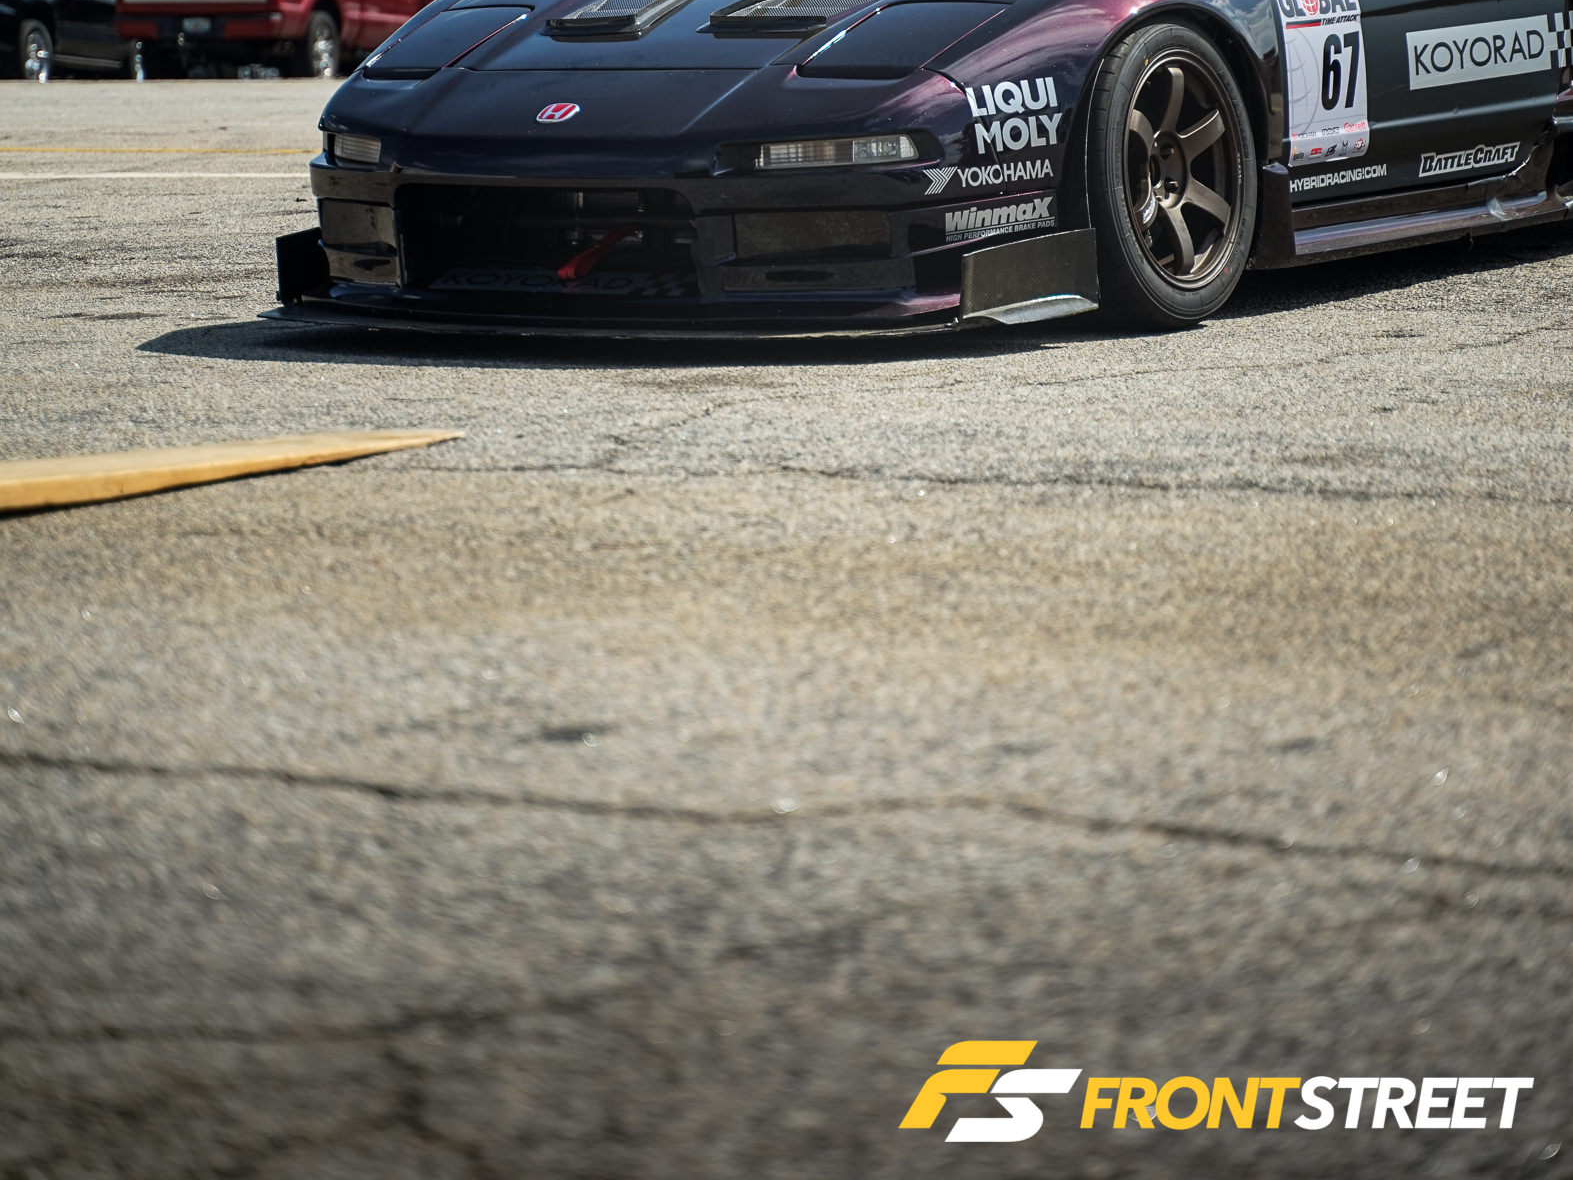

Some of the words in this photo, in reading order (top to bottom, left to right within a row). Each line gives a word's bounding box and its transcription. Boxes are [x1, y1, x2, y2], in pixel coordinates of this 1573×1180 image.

[1321, 17, 1335, 26] TIME
[1335, 14, 1358, 24] ATTACK
[1413, 29, 1545, 76] KOYORAD
[1321, 31, 1360, 111] 67
[965, 76, 1058, 117] LIQUI
[974, 112, 1063, 154] MOLY
[1344, 121, 1368, 133] Garrett
[957, 158, 1054, 188] YOKOHAMA
[945, 234, 963, 243] HIGH
[963, 226, 1013, 240] PERFORMANCE
[1014, 222, 1036, 232] BRAKE
